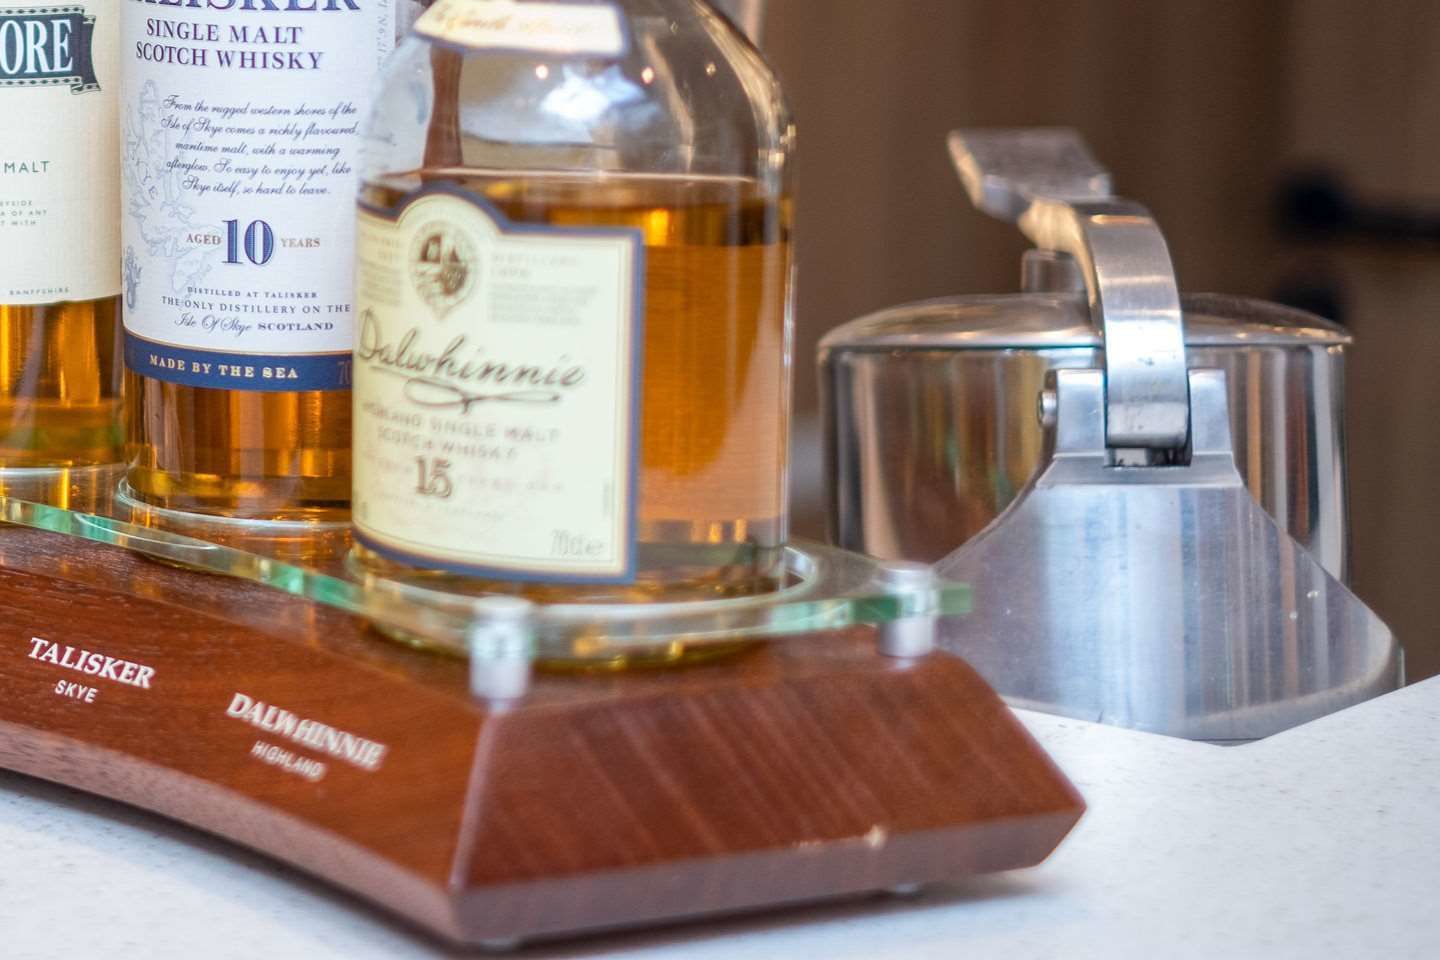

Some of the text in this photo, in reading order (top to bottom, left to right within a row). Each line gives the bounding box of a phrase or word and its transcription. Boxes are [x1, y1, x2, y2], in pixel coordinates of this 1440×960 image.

[146, 18, 303, 45] SINGLE MALT
[136, 41, 324, 70] SCOTCH WHISKY
[162, 94, 357, 120] From the rugged western shores of the
[160, 114, 181, 129] Isle
[182, 118, 193, 136] of
[192, 116, 224, 138] Skye
[225, 126, 256, 134] comes
[258, 127, 265, 135] a
[269, 123, 302, 140] richly
[175, 141, 219, 153] maritime
[252, 144, 276, 156] with
[279, 147, 287, 155] a
[289, 147, 341, 160] warming
[4, 160, 51, 173] MALT
[213, 158, 233, 174] So
[235, 167, 258, 180] easy
[261, 166, 273, 176] to
[275, 167, 305, 181] enjoy
[332, 161, 352, 175] like
[182, 175, 212, 195] Skye
[243, 186, 253, 195] so
[256, 182, 284, 195] hard
[286, 183, 297, 195] to
[186, 218, 321, 267] AGED 10 YEARS
[161, 296, 352, 315] THE ONLY DISTILLERY ON THE
[187, 286, 319, 300] DISTILLED AT TALISKER
[174, 312, 198, 329] Isle
[220, 316, 254, 338] Skye
[257, 321, 335, 331] SCOTLAND
[359, 308, 585, 387] Dalwhinnie
[148, 353, 300, 380] MADE BY THE SEA
[414, 454, 453, 498] 15
[27, 636, 157, 690] TALISKER
[54, 679, 99, 704] SKYE
[226, 691, 389, 772] DALWHINNIE
[249, 739, 328, 782] HIGHLAND
